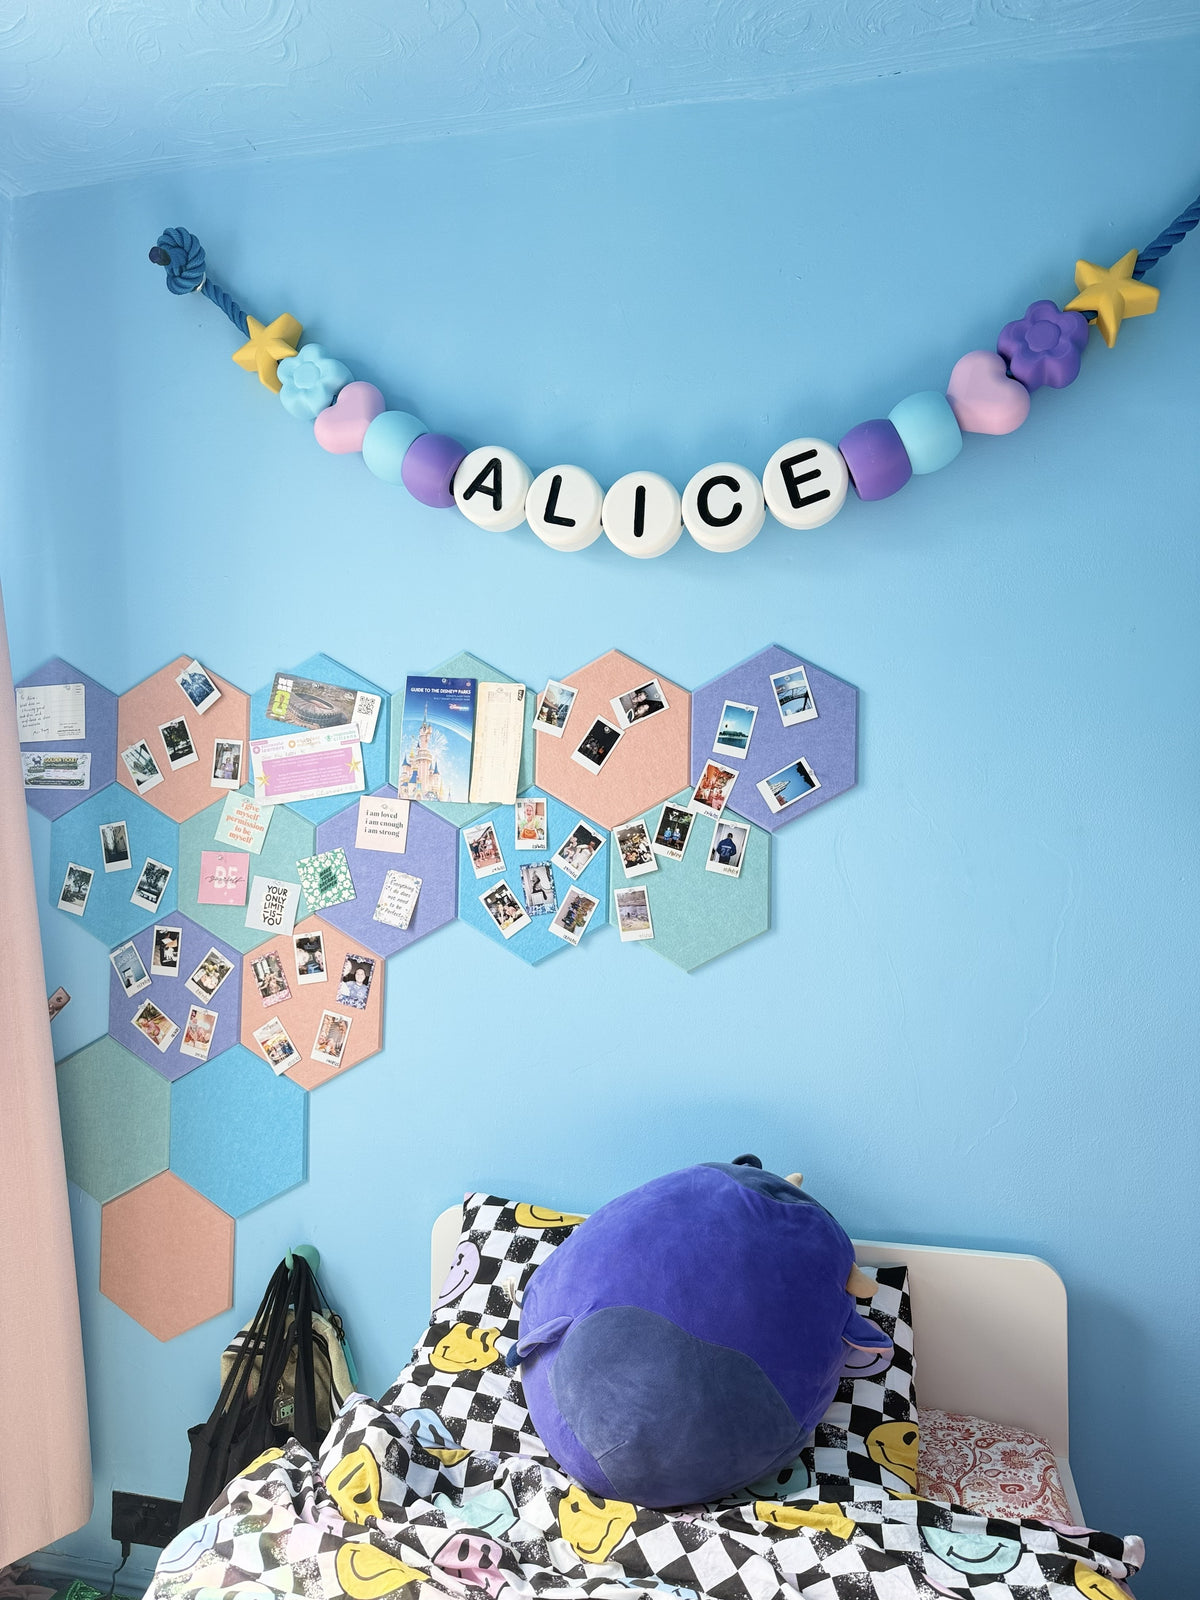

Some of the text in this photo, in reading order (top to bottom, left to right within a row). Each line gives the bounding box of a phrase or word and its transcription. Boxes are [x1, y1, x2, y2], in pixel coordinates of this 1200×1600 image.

[463, 448, 831, 537] ALICE
[245, 803, 260, 812] give
[235, 809, 261, 820] myself
[381, 811, 398, 819] loved
[225, 814, 265, 832] permission
[380, 821, 404, 829] enough
[235, 825, 251, 835] to be
[379, 829, 400, 838] strong
[228, 832, 254, 844] myself
[267, 885, 288, 896] YOUR
[265, 894, 286, 904] ONLY
[263, 902, 284, 911] LIMIT
[262, 914, 282, 926] YOU
